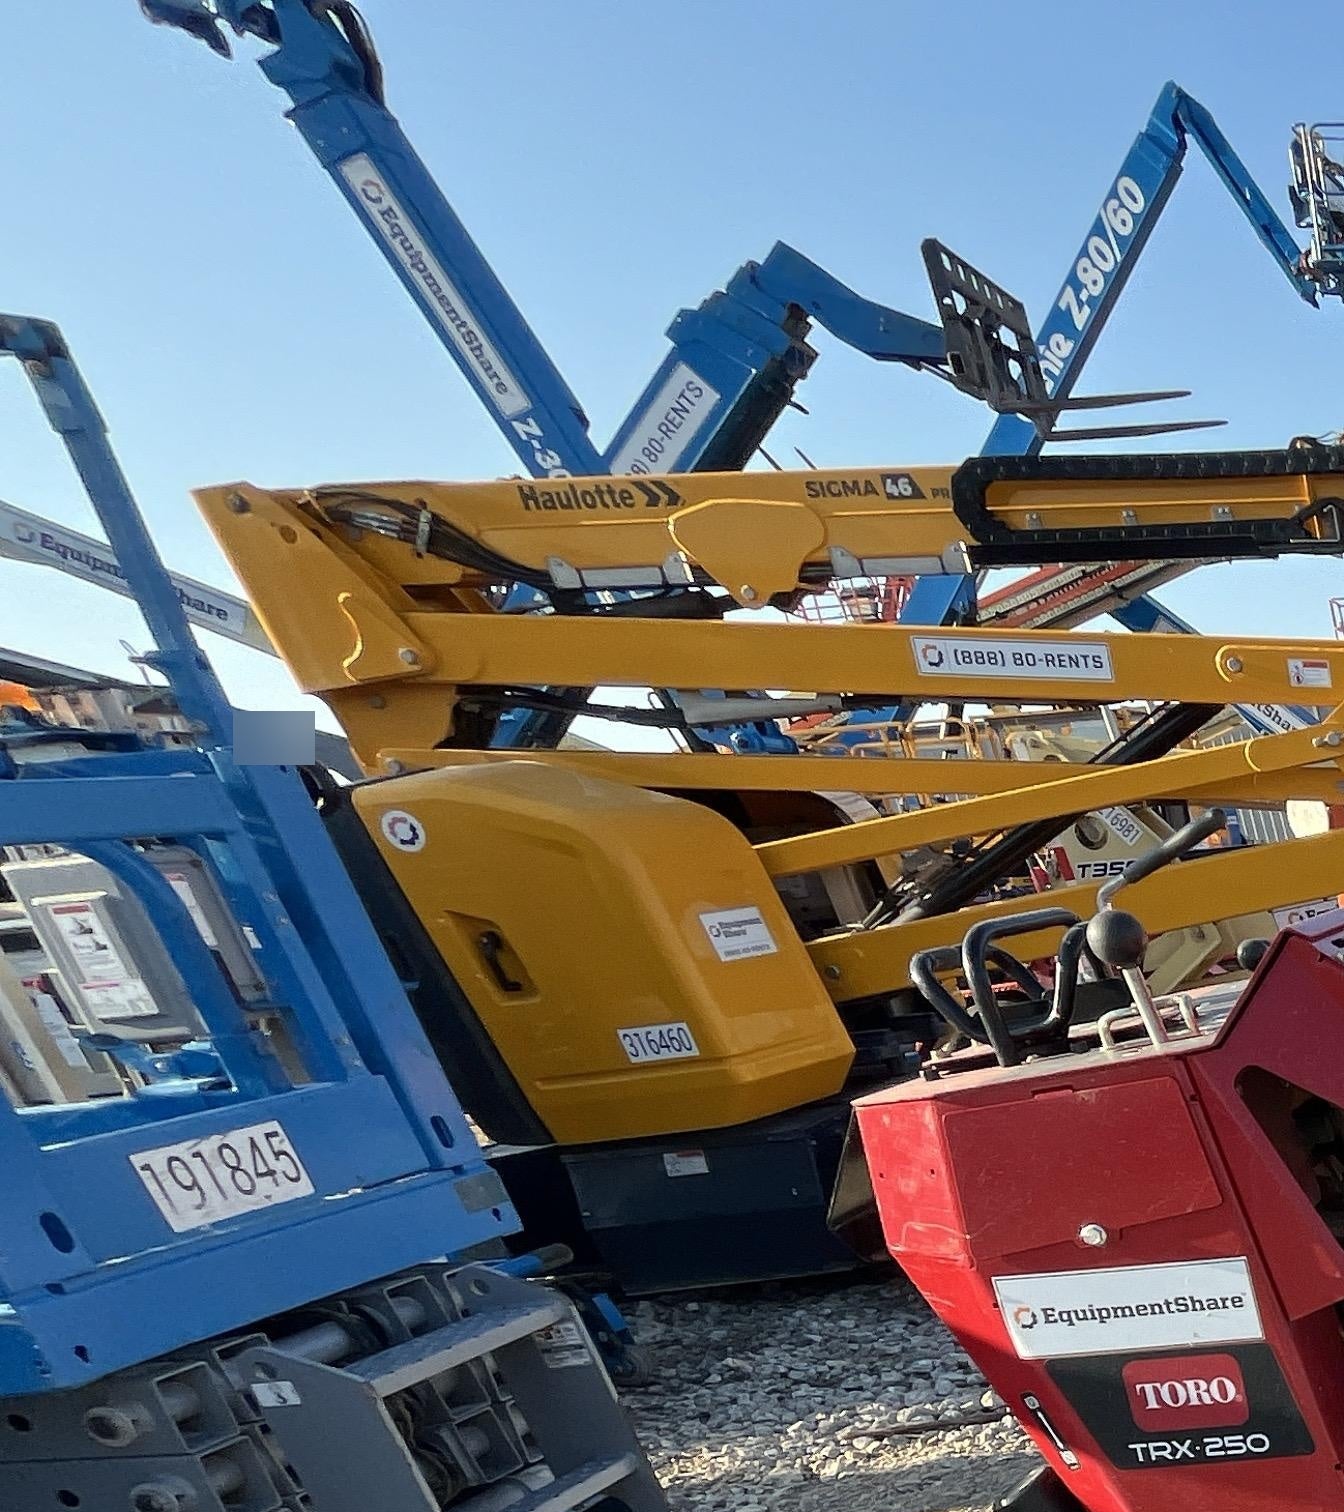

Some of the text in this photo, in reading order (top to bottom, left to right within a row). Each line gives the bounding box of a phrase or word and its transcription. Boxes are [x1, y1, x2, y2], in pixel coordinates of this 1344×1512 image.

[379, 206, 508, 396] EquipmentShare
[1039, 176, 1145, 395] nie Z-80/60
[641, 379, 705, 463] 80-RENTS
[517, 483, 635, 512] Haulotte
[804, 480, 880, 499] SIGMA
[884, 477, 914, 497] 46
[952, 647, 1104, 670] (888) 80-RENTS
[622, 1026, 694, 1059] 316460
[139, 1130, 302, 1216] 191845
[1042, 1294, 1245, 1326] EquipmentShare
[1135, 1376, 1237, 1411] TORO
